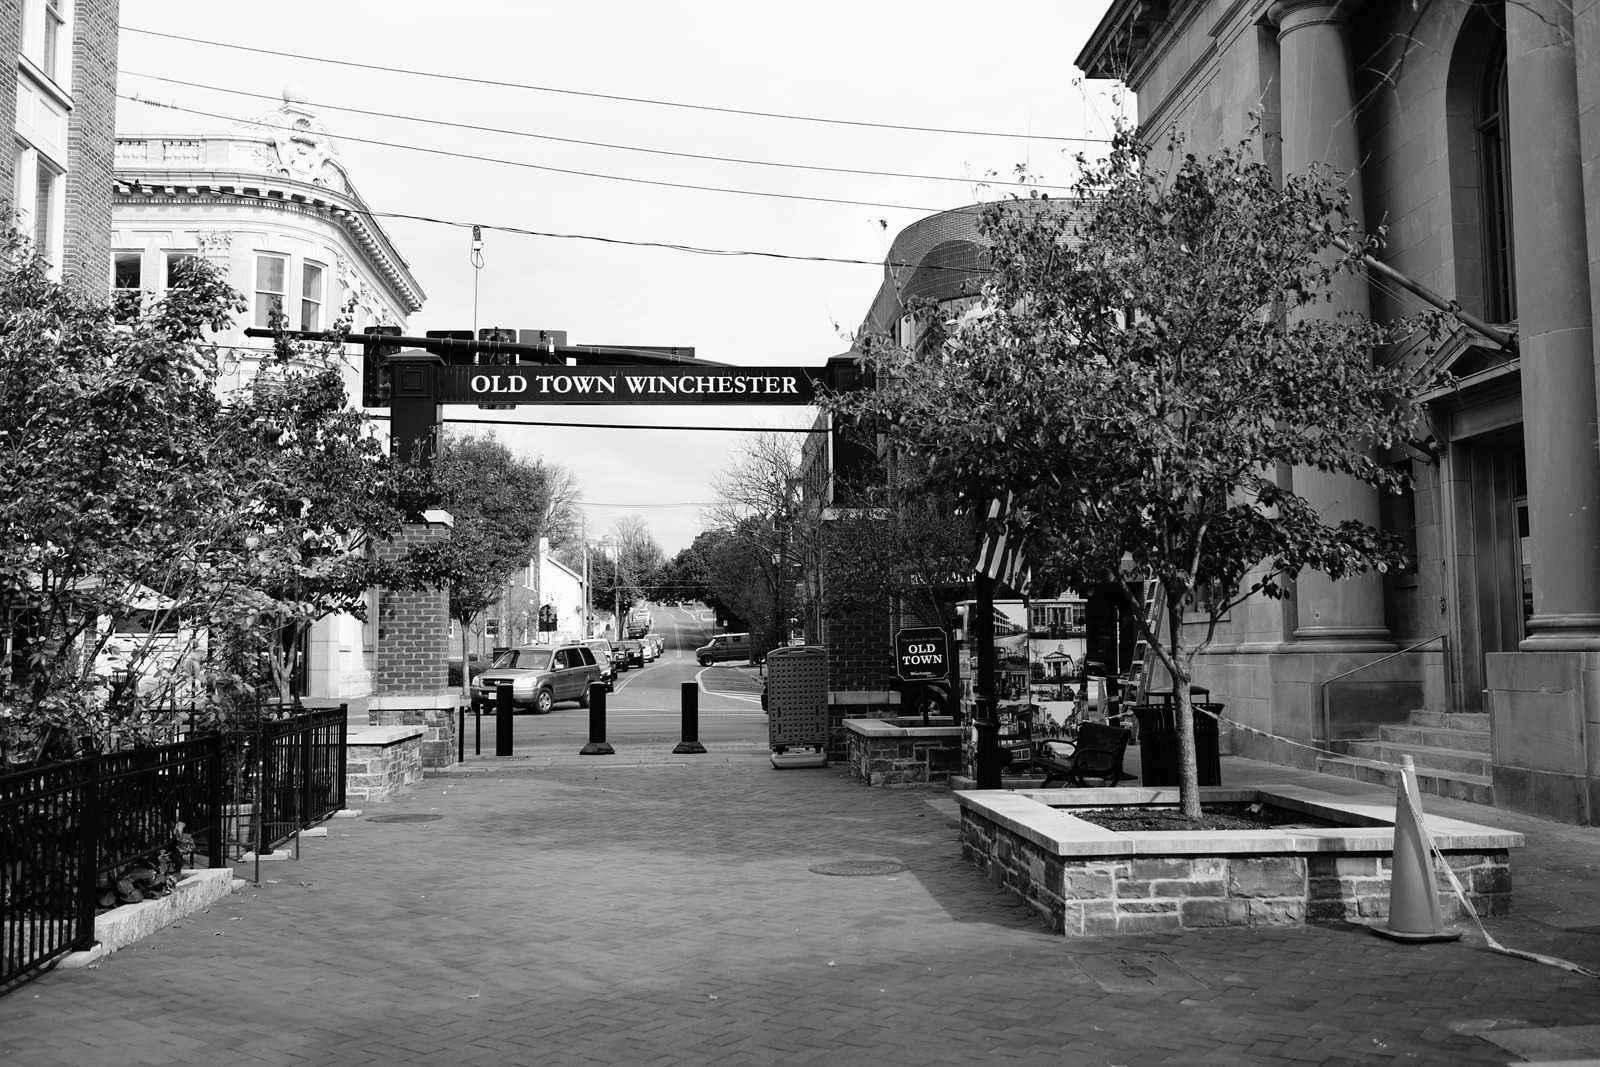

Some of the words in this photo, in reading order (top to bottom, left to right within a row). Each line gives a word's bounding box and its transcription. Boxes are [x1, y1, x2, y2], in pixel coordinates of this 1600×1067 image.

[471, 375, 528, 393] OLD
[535, 375, 617, 394] TOWN
[625, 376, 799, 394] WINCHESTER
[908, 643, 936, 654] OLD
[902, 654, 943, 665] TOWN
